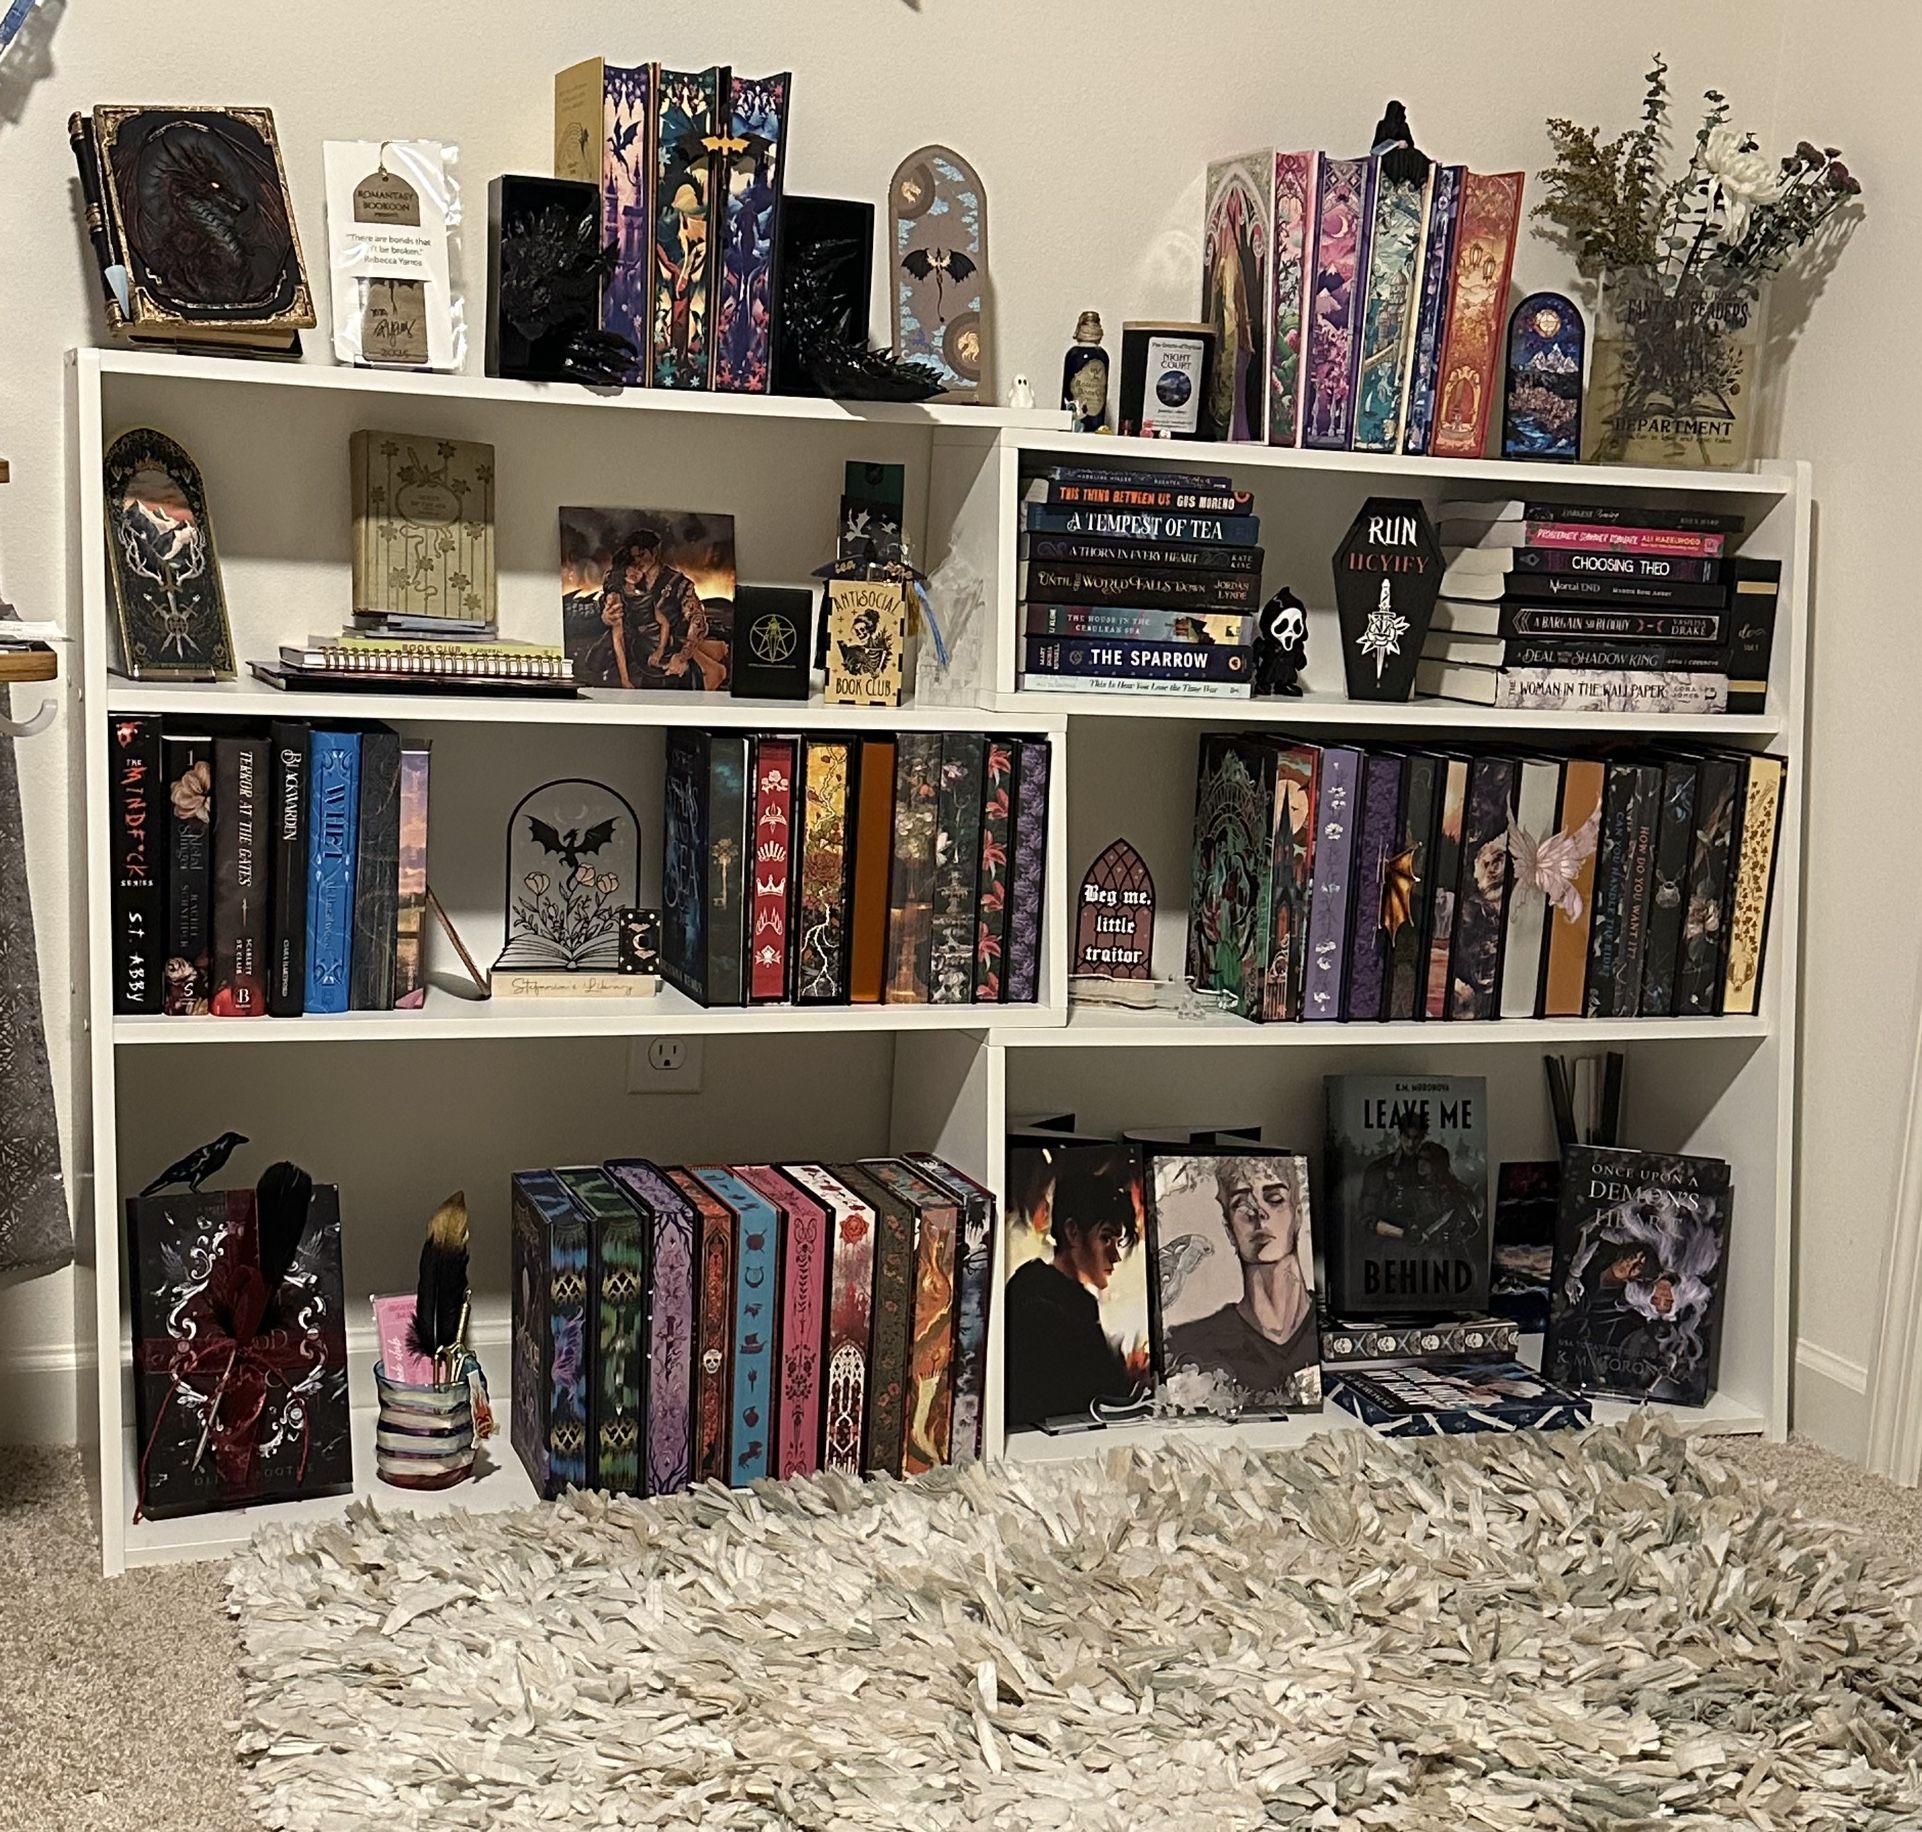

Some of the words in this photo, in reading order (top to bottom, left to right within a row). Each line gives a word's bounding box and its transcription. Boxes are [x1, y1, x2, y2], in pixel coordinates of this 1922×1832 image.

[1161, 361, 1192, 370] COURT
[1163, 352, 1191, 362] NIGHT
[1614, 419, 1733, 436] DEPARTMENT
[1059, 487, 1079, 500] THIS
[1084, 488, 1110, 502] THING
[1113, 490, 1154, 504] BETWEEN
[1158, 493, 1171, 506] US
[1176, 495, 1196, 508] GUS
[1199, 496, 1235, 510] MORENO
[1067, 512, 1082, 532] A
[1086, 513, 1162, 536] TEMPEST
[1166, 518, 1187, 536] OF
[1190, 520, 1222, 539] TEA
[1368, 516, 1418, 547] RUN
[1070, 546, 1077, 556] A
[1078, 546, 1116, 558] THORN
[1118, 549, 1128, 558] IN
[1130, 550, 1160, 562] EVERY
[1164, 552, 1199, 564] HEART
[1572, 556, 1634, 573] CHOOSING
[1640, 560, 1670, 576] THEO
[1214, 581, 1249, 591] JORDAN
[833, 590, 902, 614] ANTISOCIAL
[1067, 614, 1085, 622] THE
[1088, 616, 1116, 624] HOUSE
[1132, 618, 1150, 626] THE
[1542, 618, 1582, 630] BARGAIN
[1596, 619, 1630, 631] BLOODY
[1671, 625, 1706, 636] DRAKE
[402, 644, 430, 652] BOOK
[436, 644, 461, 653] CLUB
[1091, 649, 1122, 666] THE
[1130, 651, 1208, 668] SPARROW
[1522, 648, 1556, 663] DEAL
[1571, 650, 1628, 666] SHADOW
[1628, 653, 1659, 666] KING
[836, 678, 862, 696] BOOK
[866, 679, 890, 696] CLUB
[1090, 679, 1107, 688] This
[1508, 680, 1516, 697] THE
[1520, 682, 1560, 698] WOMAN
[1564, 682, 1574, 697] IN
[1578, 682, 1600, 698] THE
[1602, 684, 1666, 698] WALLPAPER
[240, 751, 252, 798] TERROR
[280, 749, 302, 840] BLACKWARDEN
[239, 800, 252, 817] AT
[239, 821, 252, 846] THE
[1616, 812, 1624, 836] CAN
[1640, 826, 1650, 854] HOW
[1613, 841, 1622, 862] YOU
[238, 848, 252, 887] GATES
[1636, 857, 1646, 874] DO
[1084, 884, 1116, 906] Beg
[1633, 878, 1644, 901] YOU
[1096, 915, 1136, 934] little
[1630, 904, 1640, 938] WANT
[1086, 946, 1142, 963] traitor
[1626, 940, 1638, 960] IT?
[1364, 1099, 1430, 1128] LEAVE
[1440, 1099, 1472, 1128] ME
[1592, 1164, 1634, 1178] ONCE
[1640, 1170, 1682, 1184] UPON
[1688, 1176, 1698, 1188] A
[1588, 1180, 1700, 1210] DEMON'S
[1364, 1260, 1472, 1294] BEHIND
